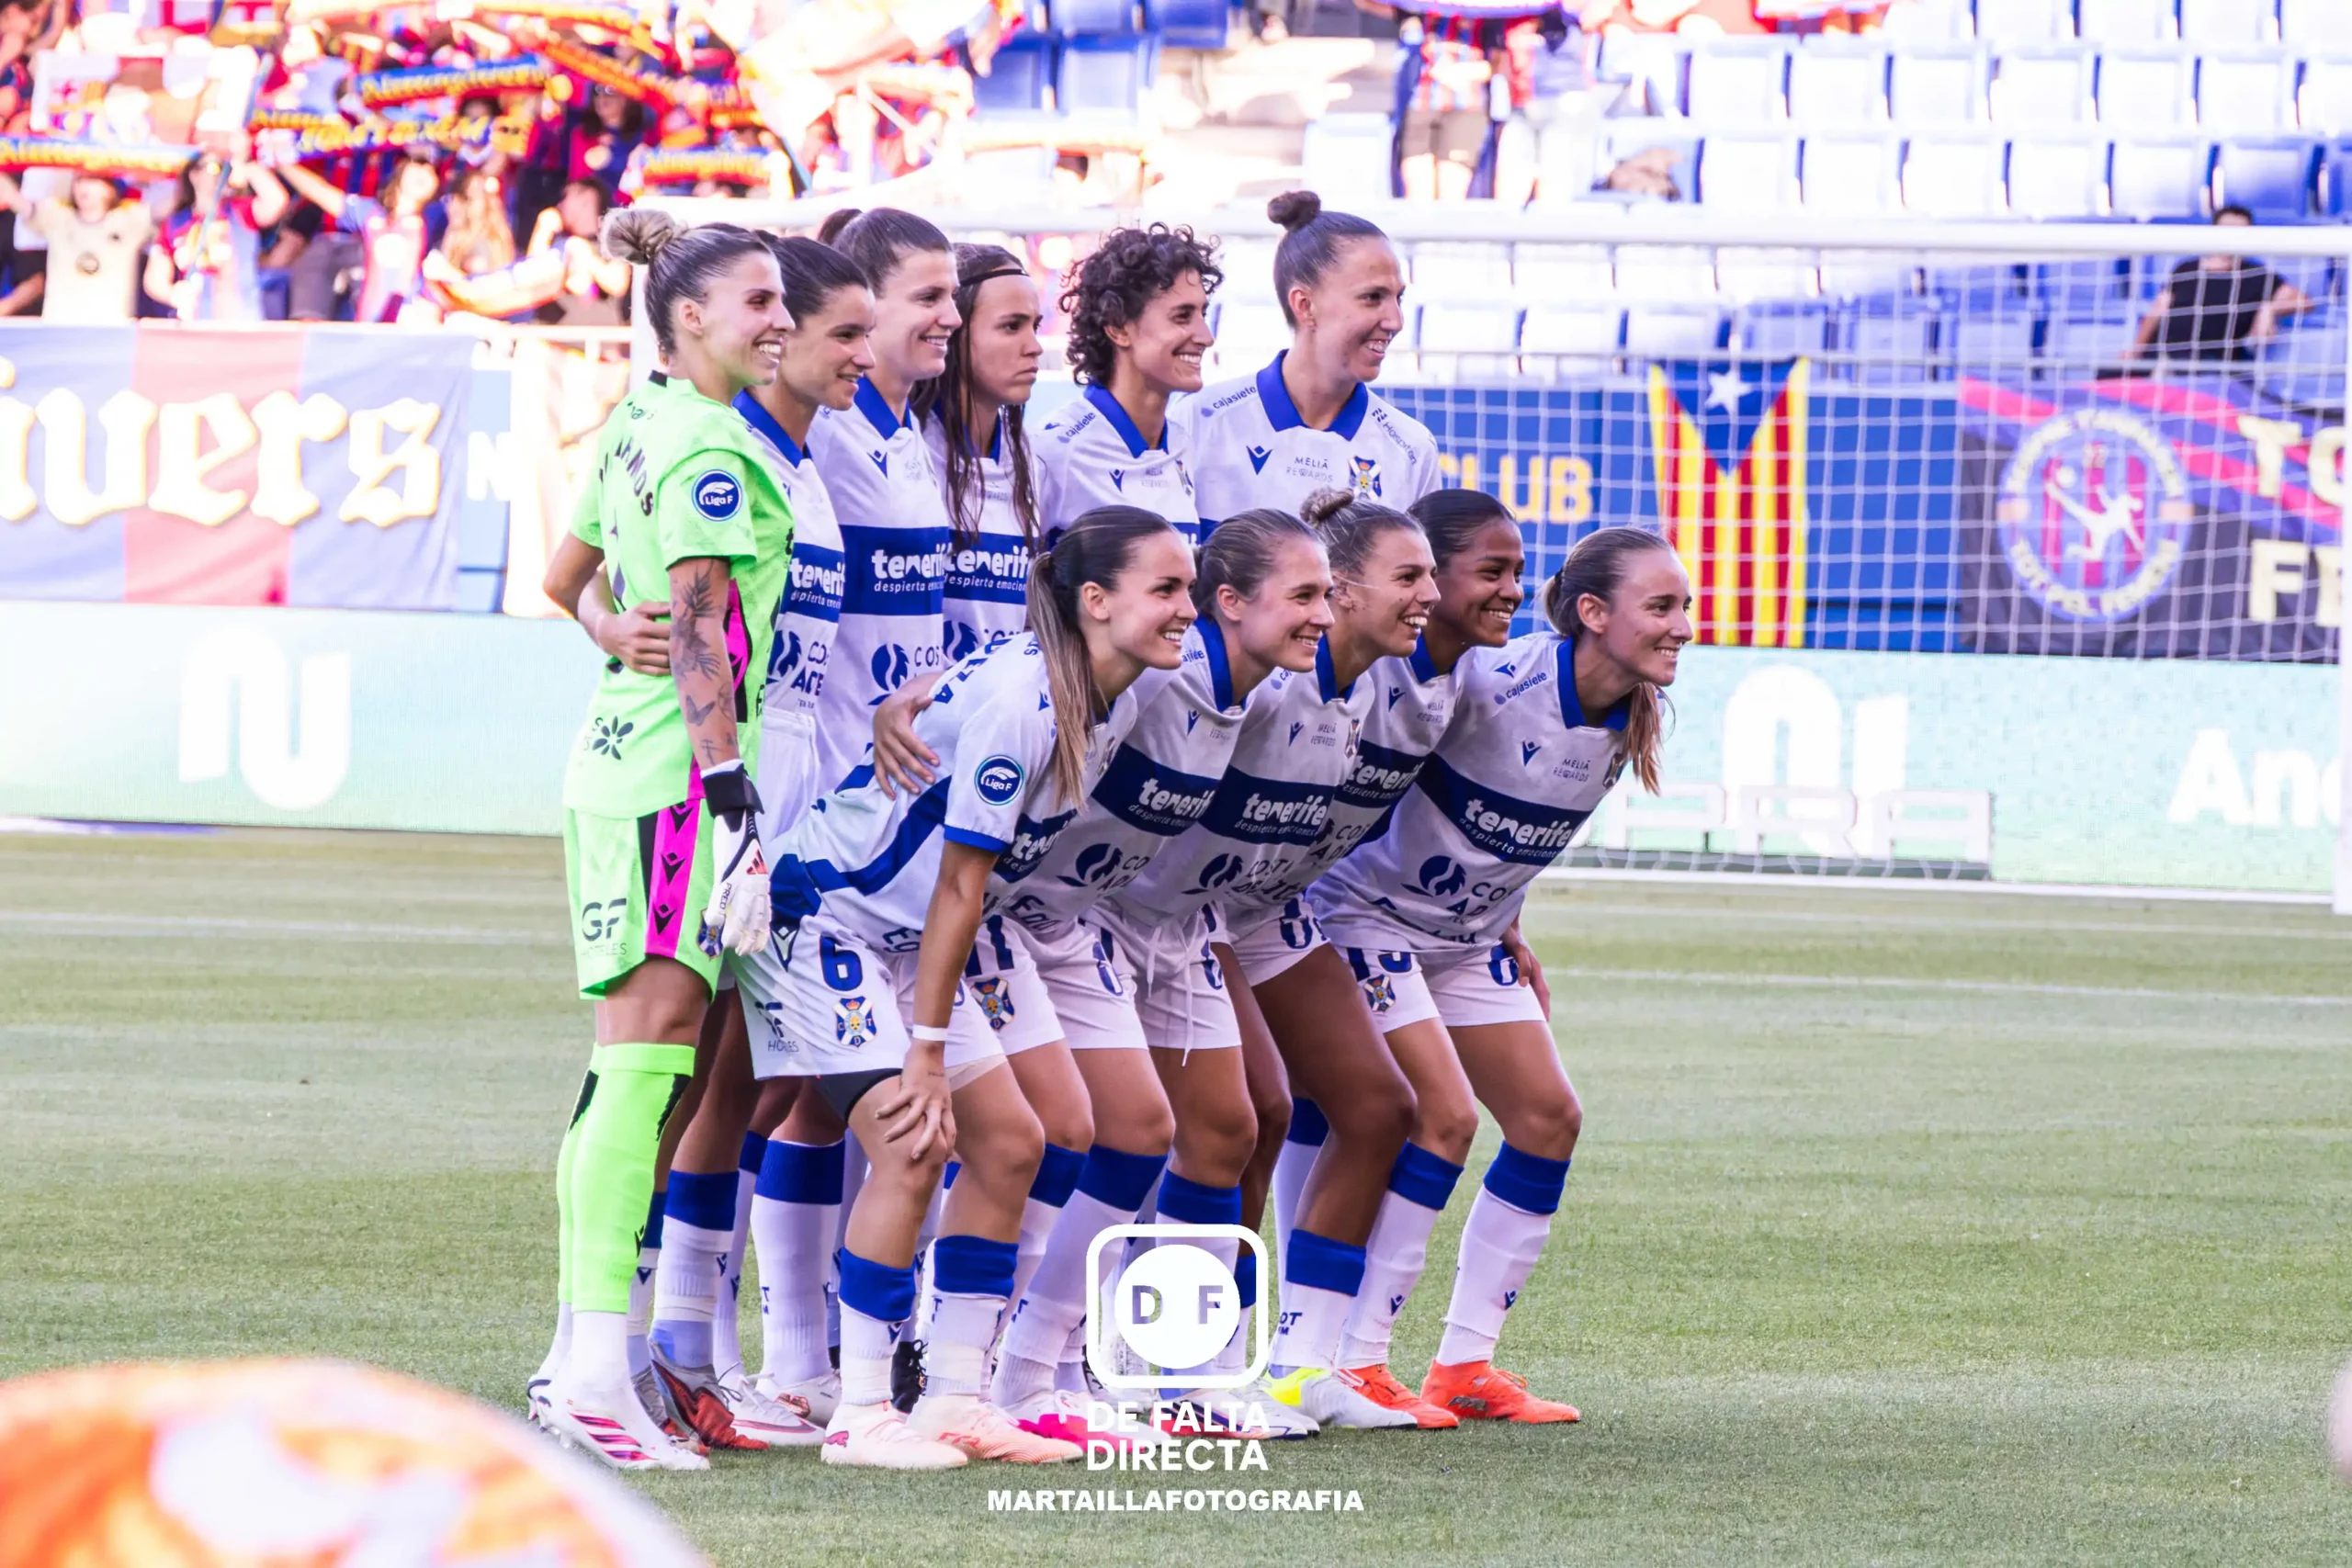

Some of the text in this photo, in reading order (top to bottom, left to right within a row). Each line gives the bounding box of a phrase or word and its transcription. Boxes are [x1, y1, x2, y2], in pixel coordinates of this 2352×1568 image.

[705, 495, 727, 507] Liga
[985, 778, 1004, 791] Liga
[1242, 793, 1328, 826] tenerife
[1465, 798, 1574, 847] tenerife
[582, 897, 628, 942] GF
[820, 932, 864, 992] 6
